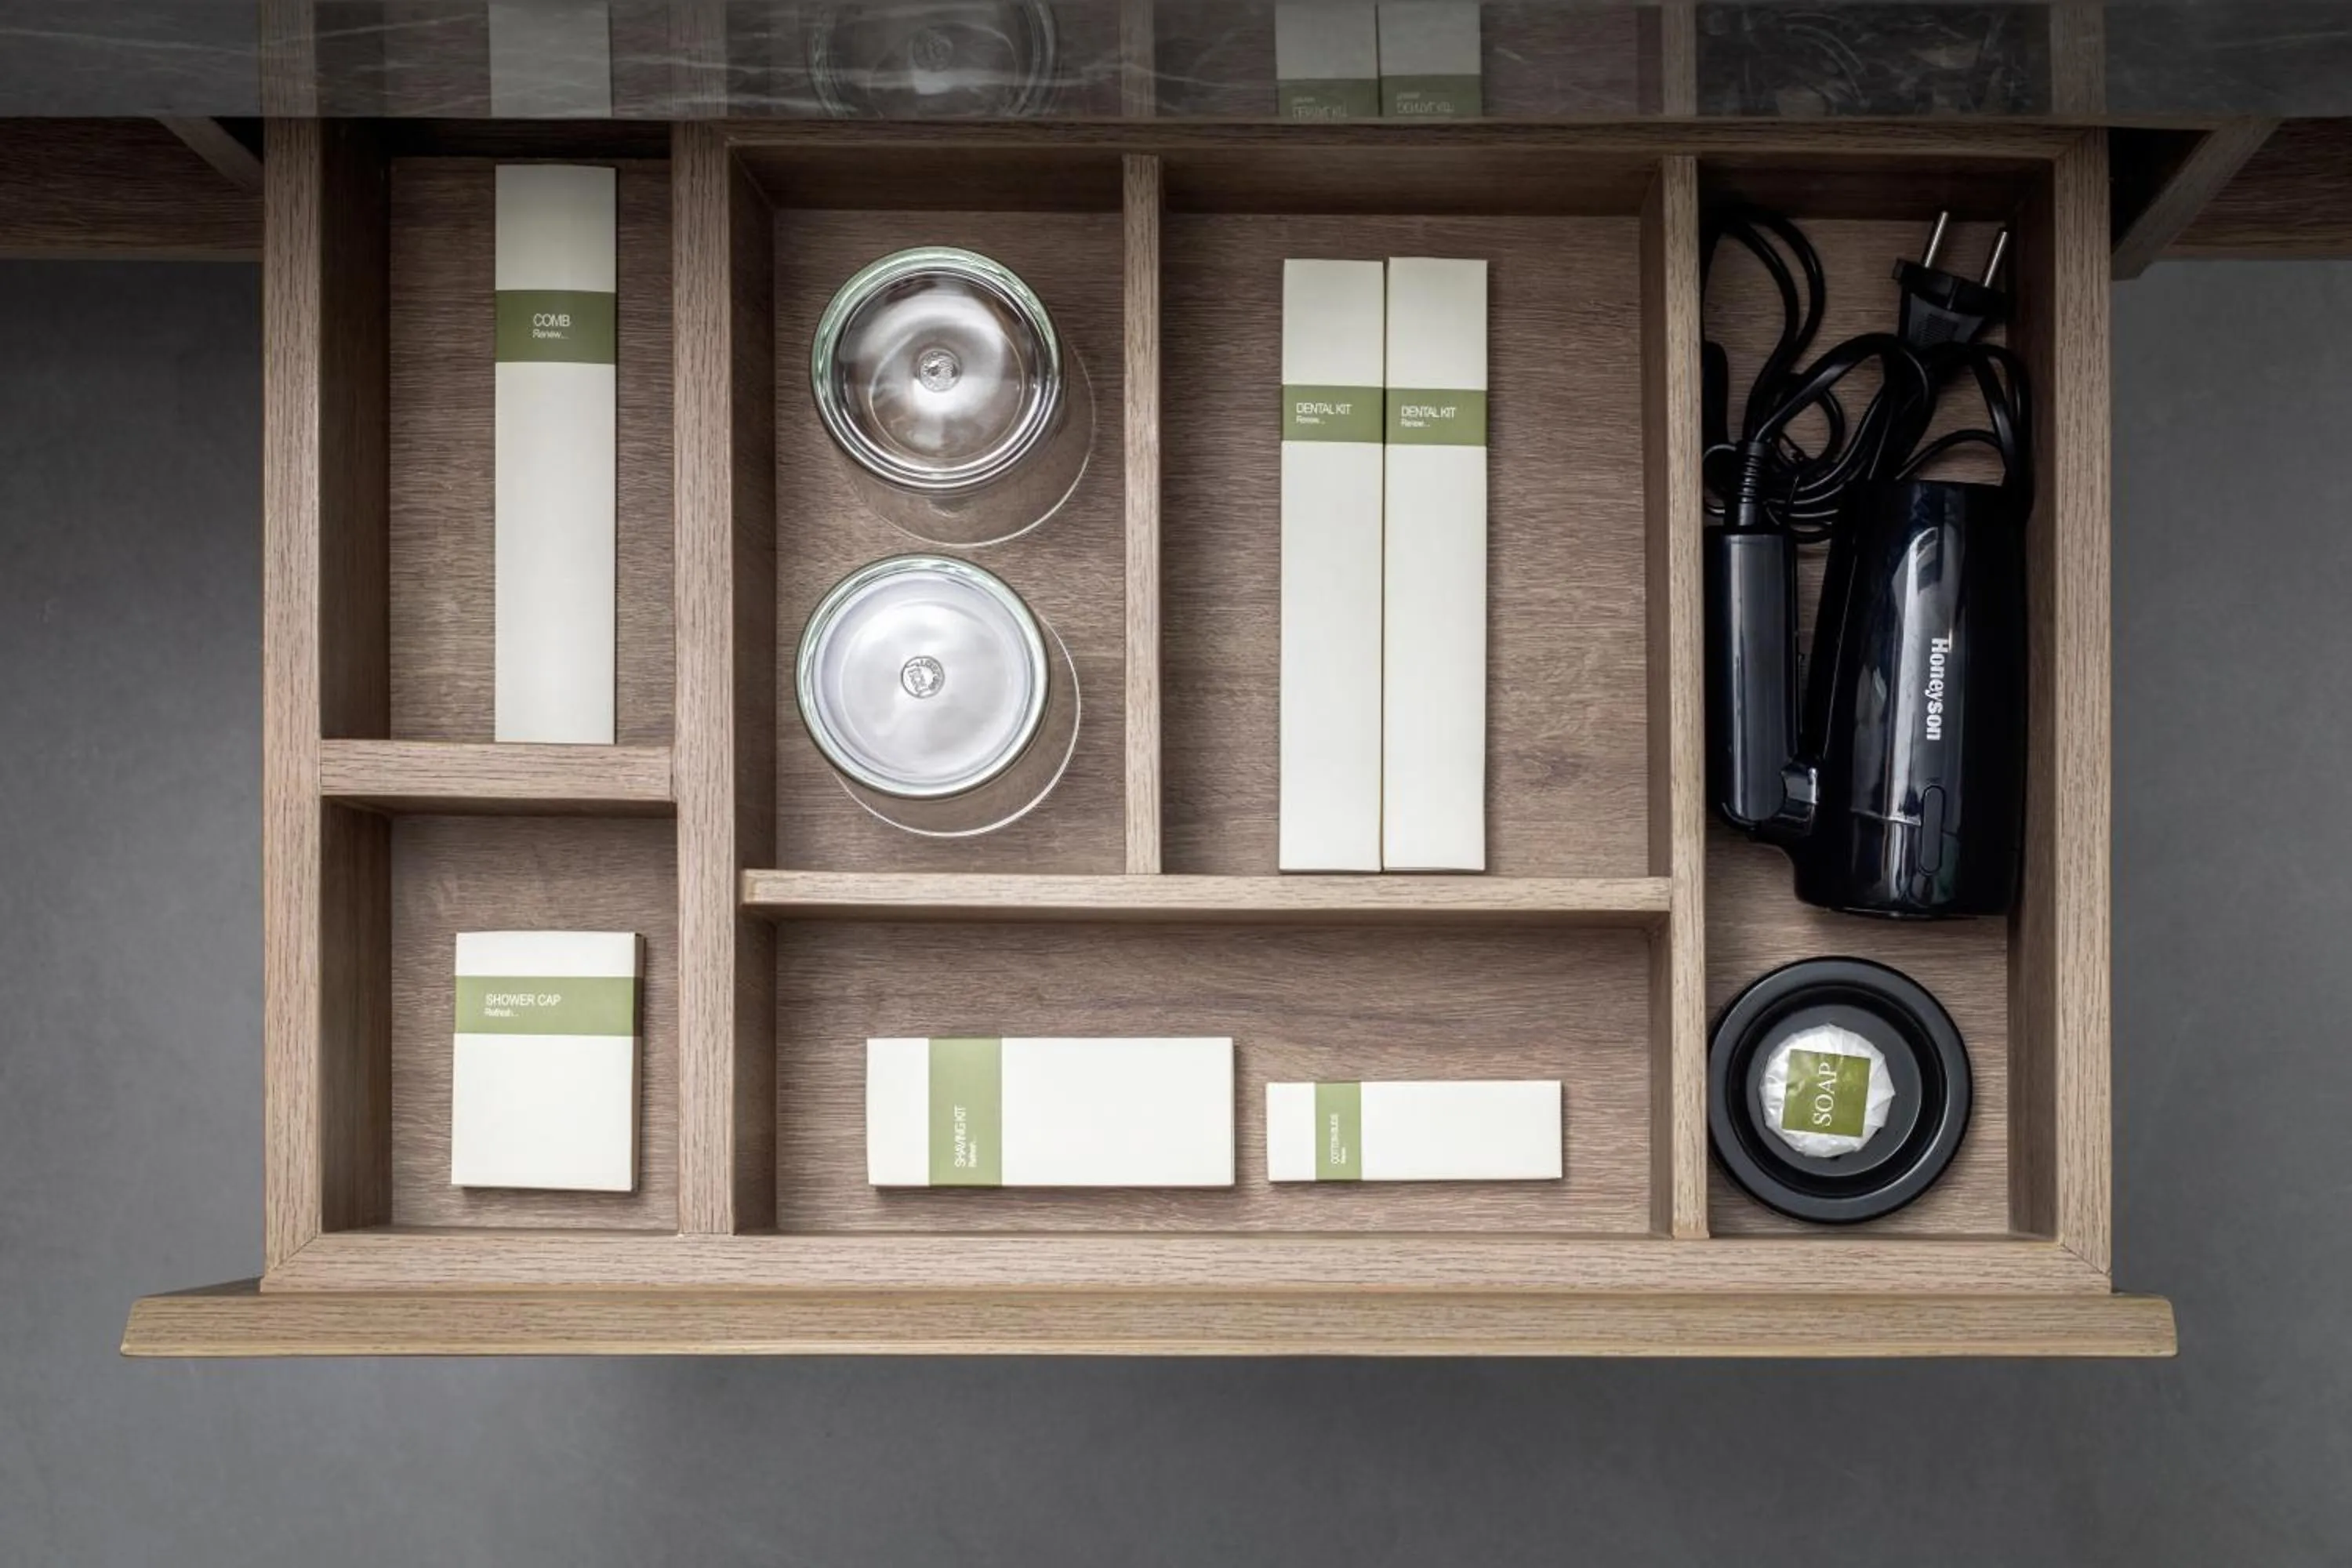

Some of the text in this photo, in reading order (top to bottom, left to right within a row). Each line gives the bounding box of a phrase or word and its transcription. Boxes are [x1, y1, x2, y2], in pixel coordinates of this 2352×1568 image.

[533, 313, 571, 327] COMB
[1296, 402, 1352, 415] DENTAL KIT
[1401, 405, 1456, 418] DENTAL KIT
[1925, 637, 1949, 741] Honeyson
[486, 993, 562, 1007] SHOWER CAP
[1813, 1062, 1837, 1127] SOAP
[954, 1104, 966, 1167] SHAVING KIT
